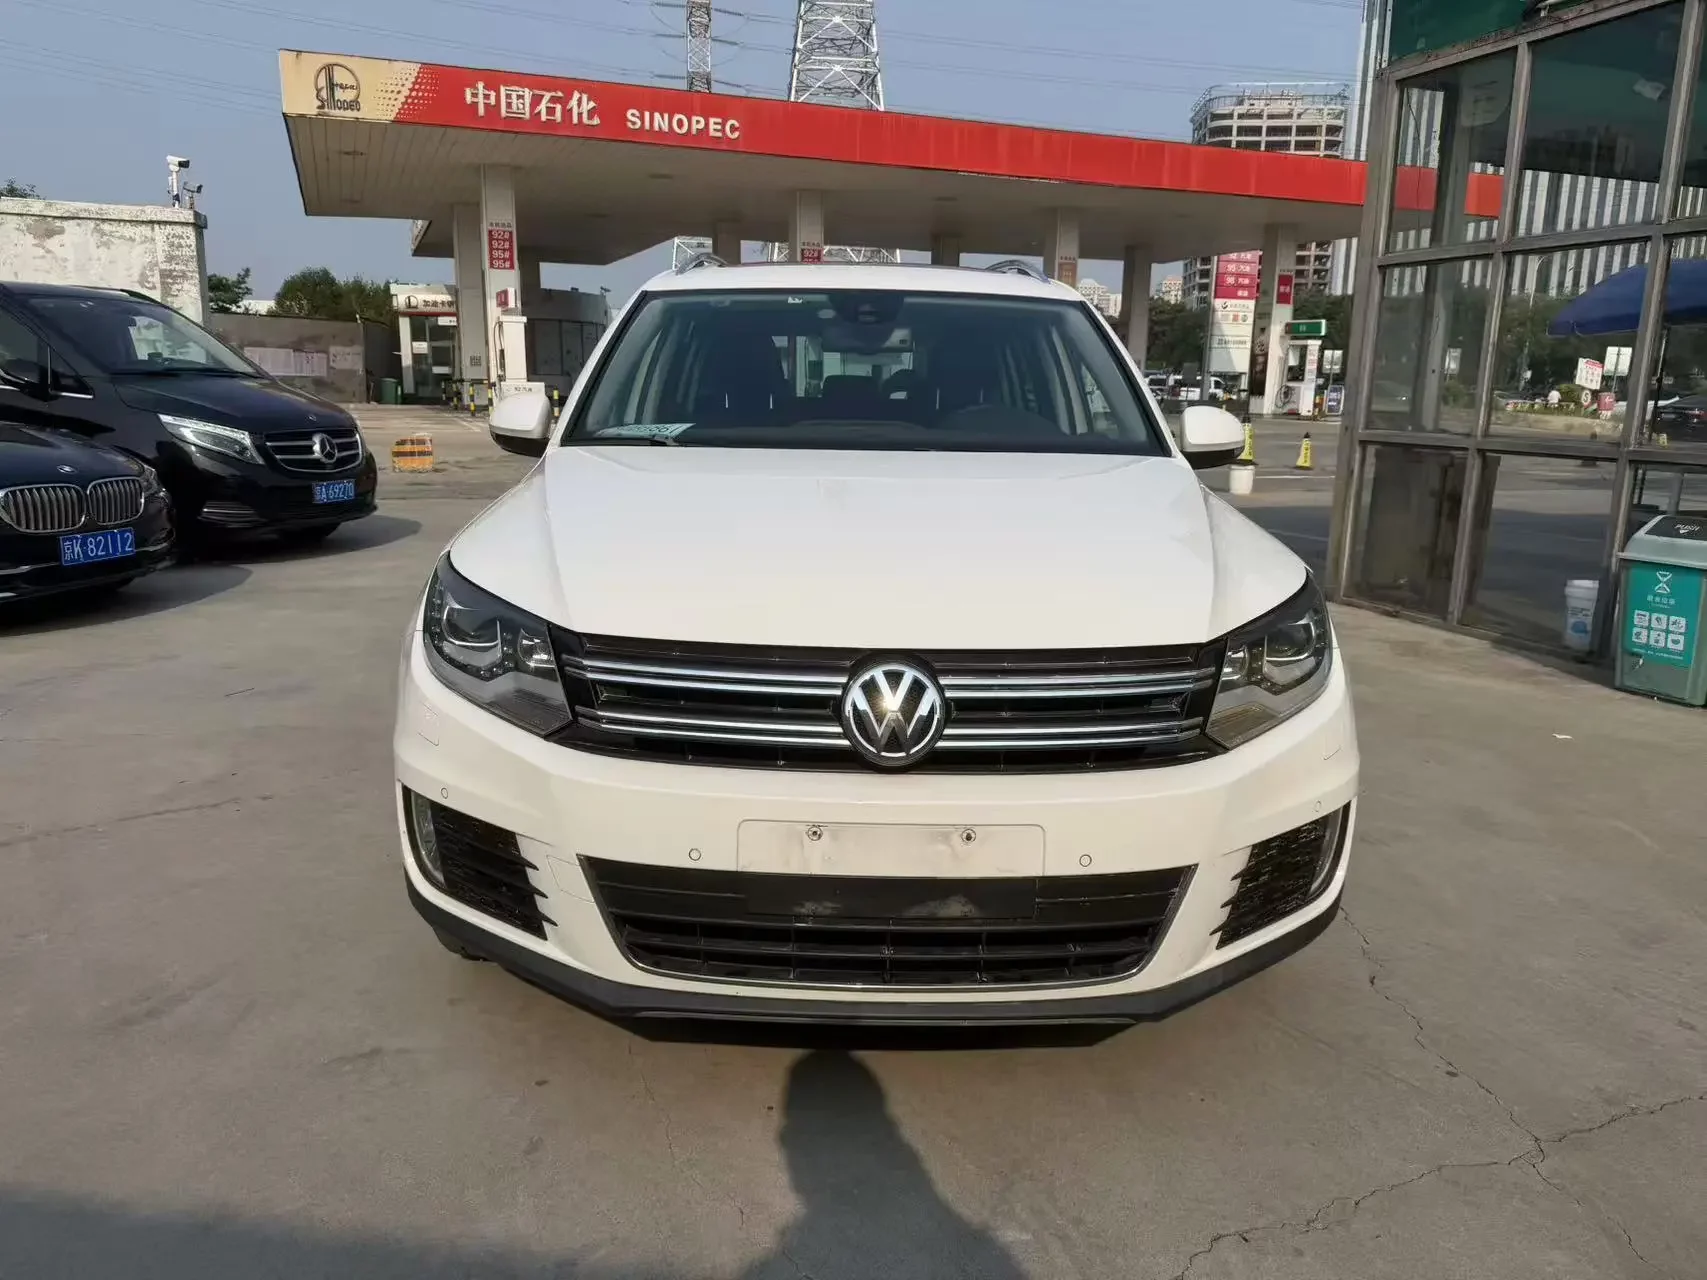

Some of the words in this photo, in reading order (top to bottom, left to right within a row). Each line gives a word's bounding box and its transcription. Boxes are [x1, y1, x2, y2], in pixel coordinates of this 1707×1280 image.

[465, 81, 600, 126] 中国石化
[626, 108, 740, 139] SINOPEC
[491, 230, 510, 239] 92#
[491, 240, 510, 249] 92#
[492, 250, 510, 259] 95#
[493, 260, 511, 268] 95#
